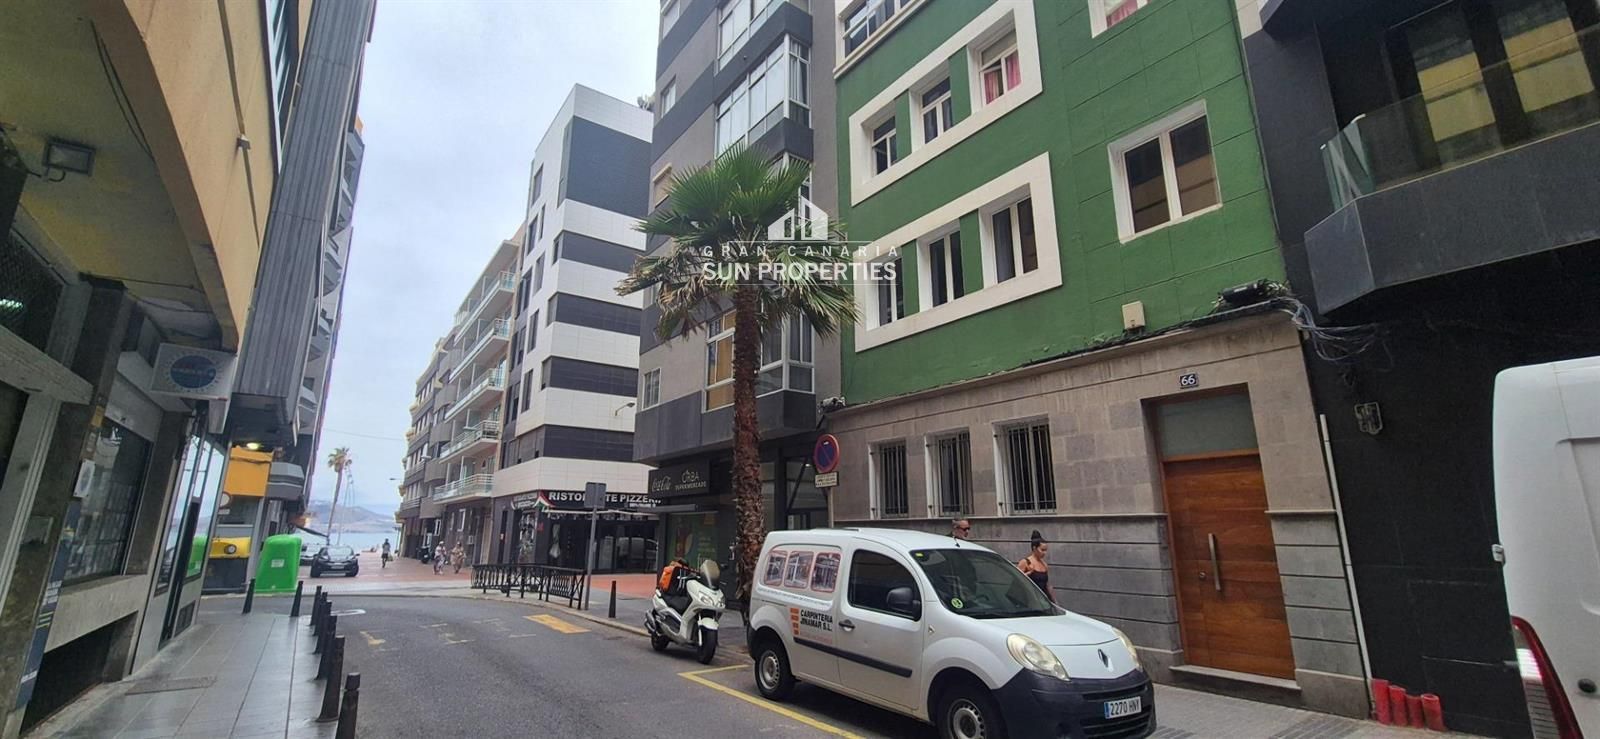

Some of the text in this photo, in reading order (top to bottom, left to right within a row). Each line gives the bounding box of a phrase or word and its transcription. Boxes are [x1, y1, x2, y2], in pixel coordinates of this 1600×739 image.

[1181, 374, 1196, 386] 66
[549, 492, 617, 503] RISTOTE
[1110, 701, 1127, 716] 2270
